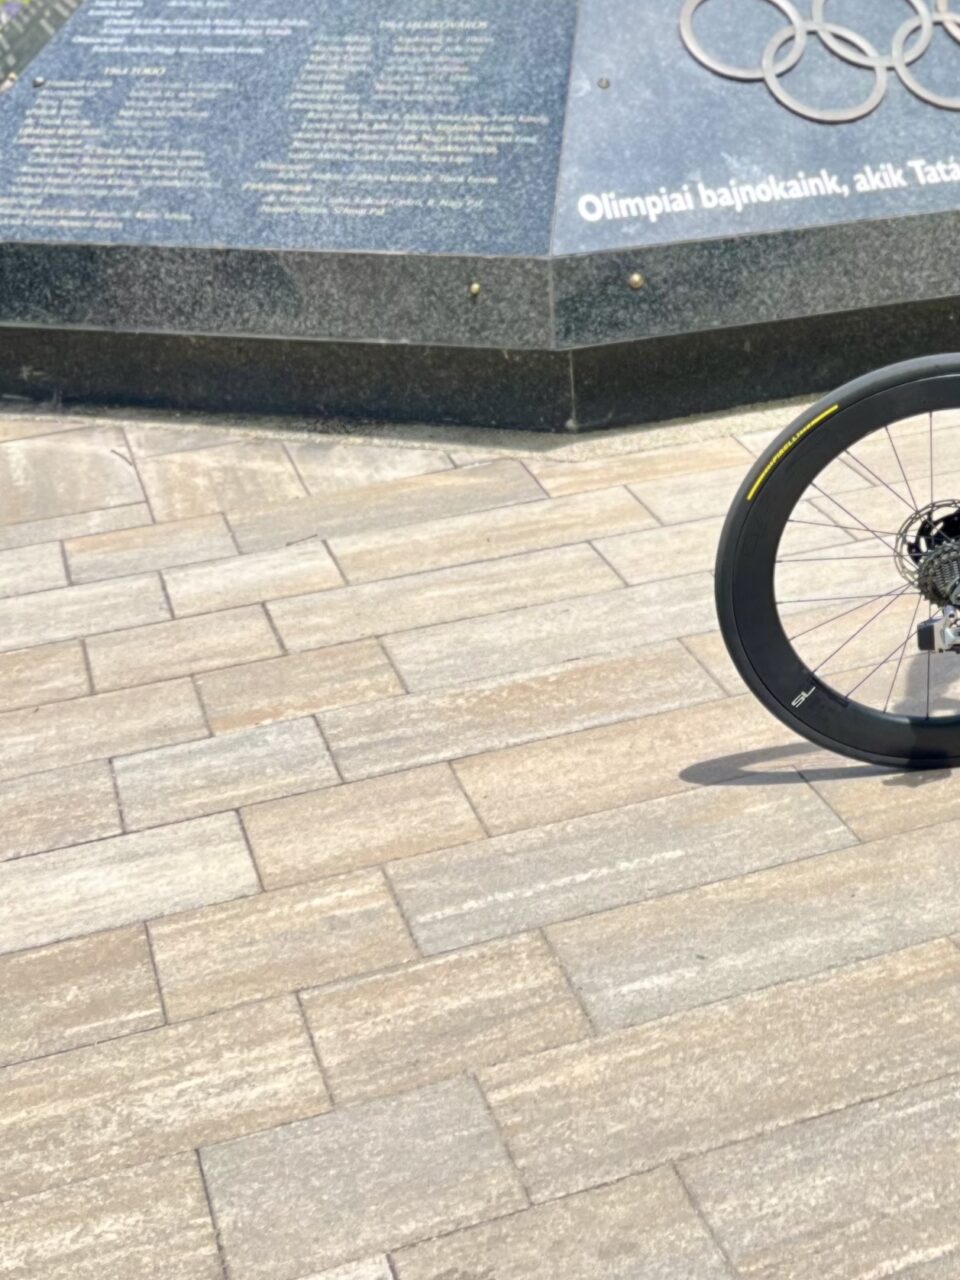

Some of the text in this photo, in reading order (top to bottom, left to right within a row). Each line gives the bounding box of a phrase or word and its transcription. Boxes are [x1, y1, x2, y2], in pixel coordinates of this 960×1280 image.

[578, 183, 694, 223] Olimpiai
[698, 168, 850, 213] bajnokaink,
[853, 162, 907, 193] akik
